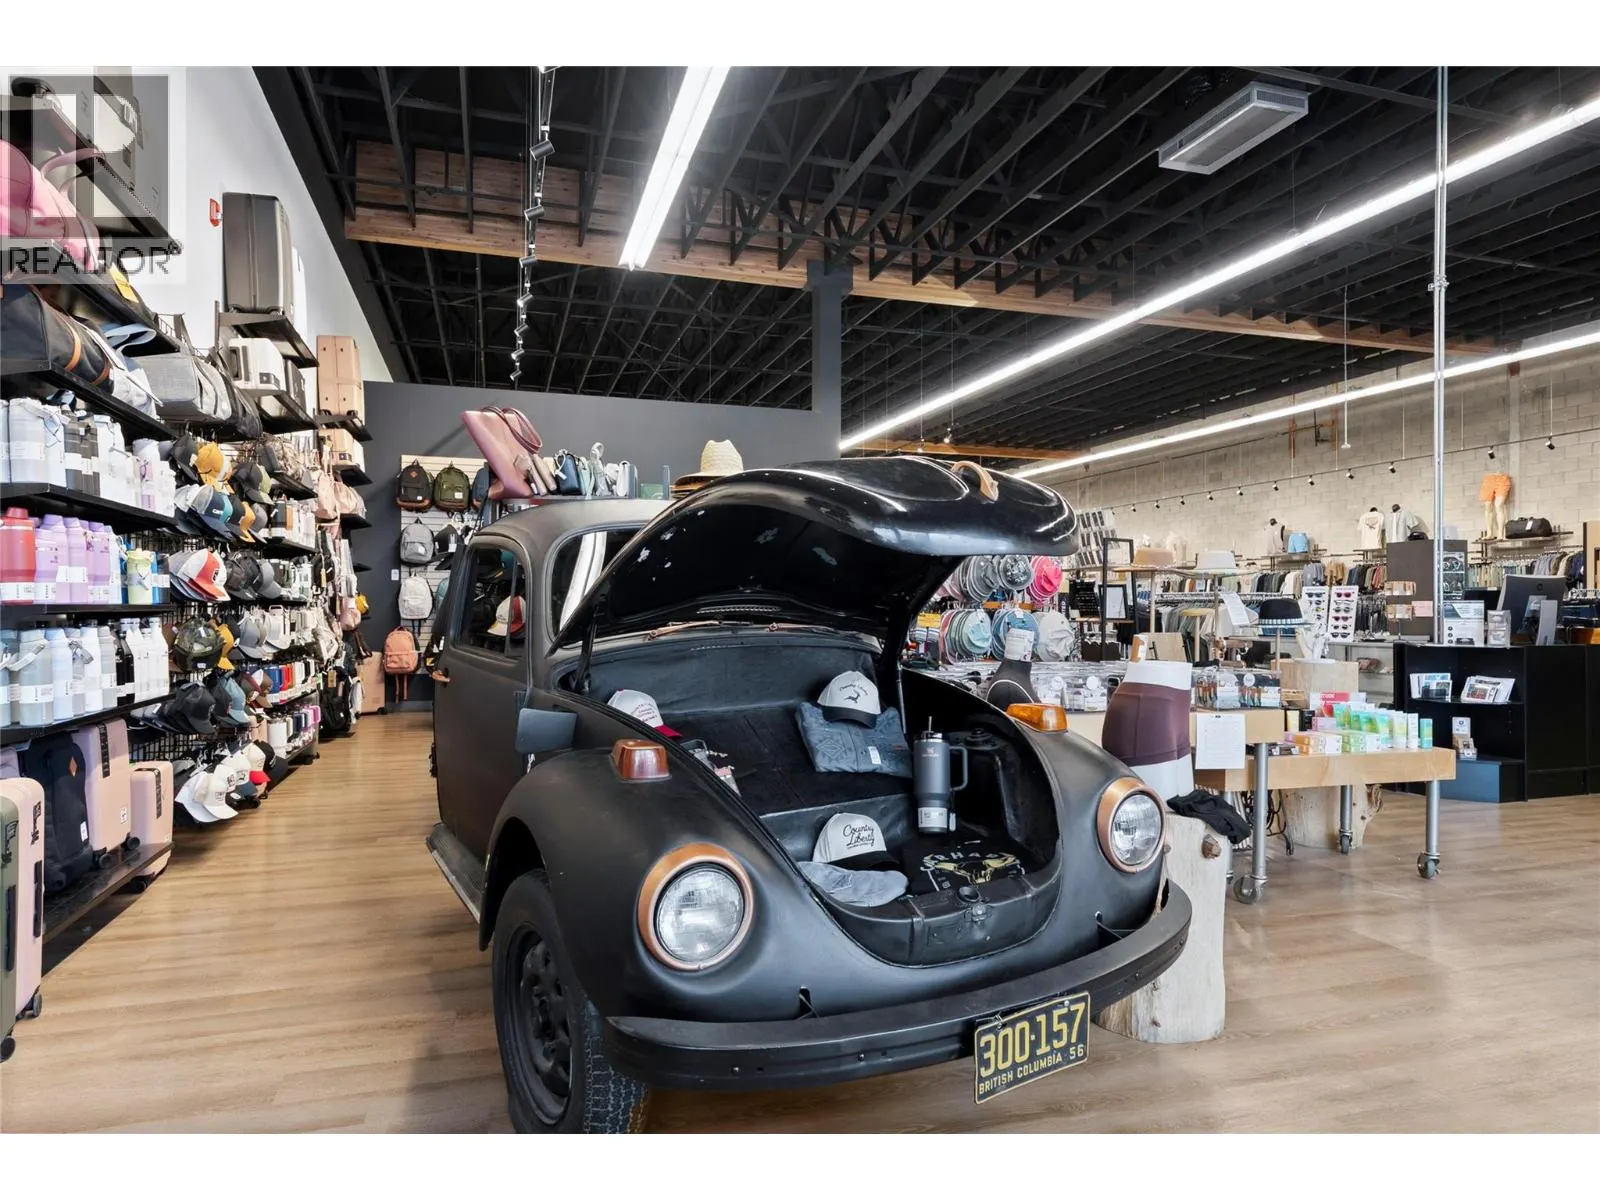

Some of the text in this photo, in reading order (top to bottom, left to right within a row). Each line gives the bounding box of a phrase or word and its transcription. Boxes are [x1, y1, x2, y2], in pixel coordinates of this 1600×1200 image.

[842, 824, 875, 837] Country
[846, 833, 875, 847] Liberty
[978, 1044, 1084, 1095] BRITISH COLUMBIA 56
